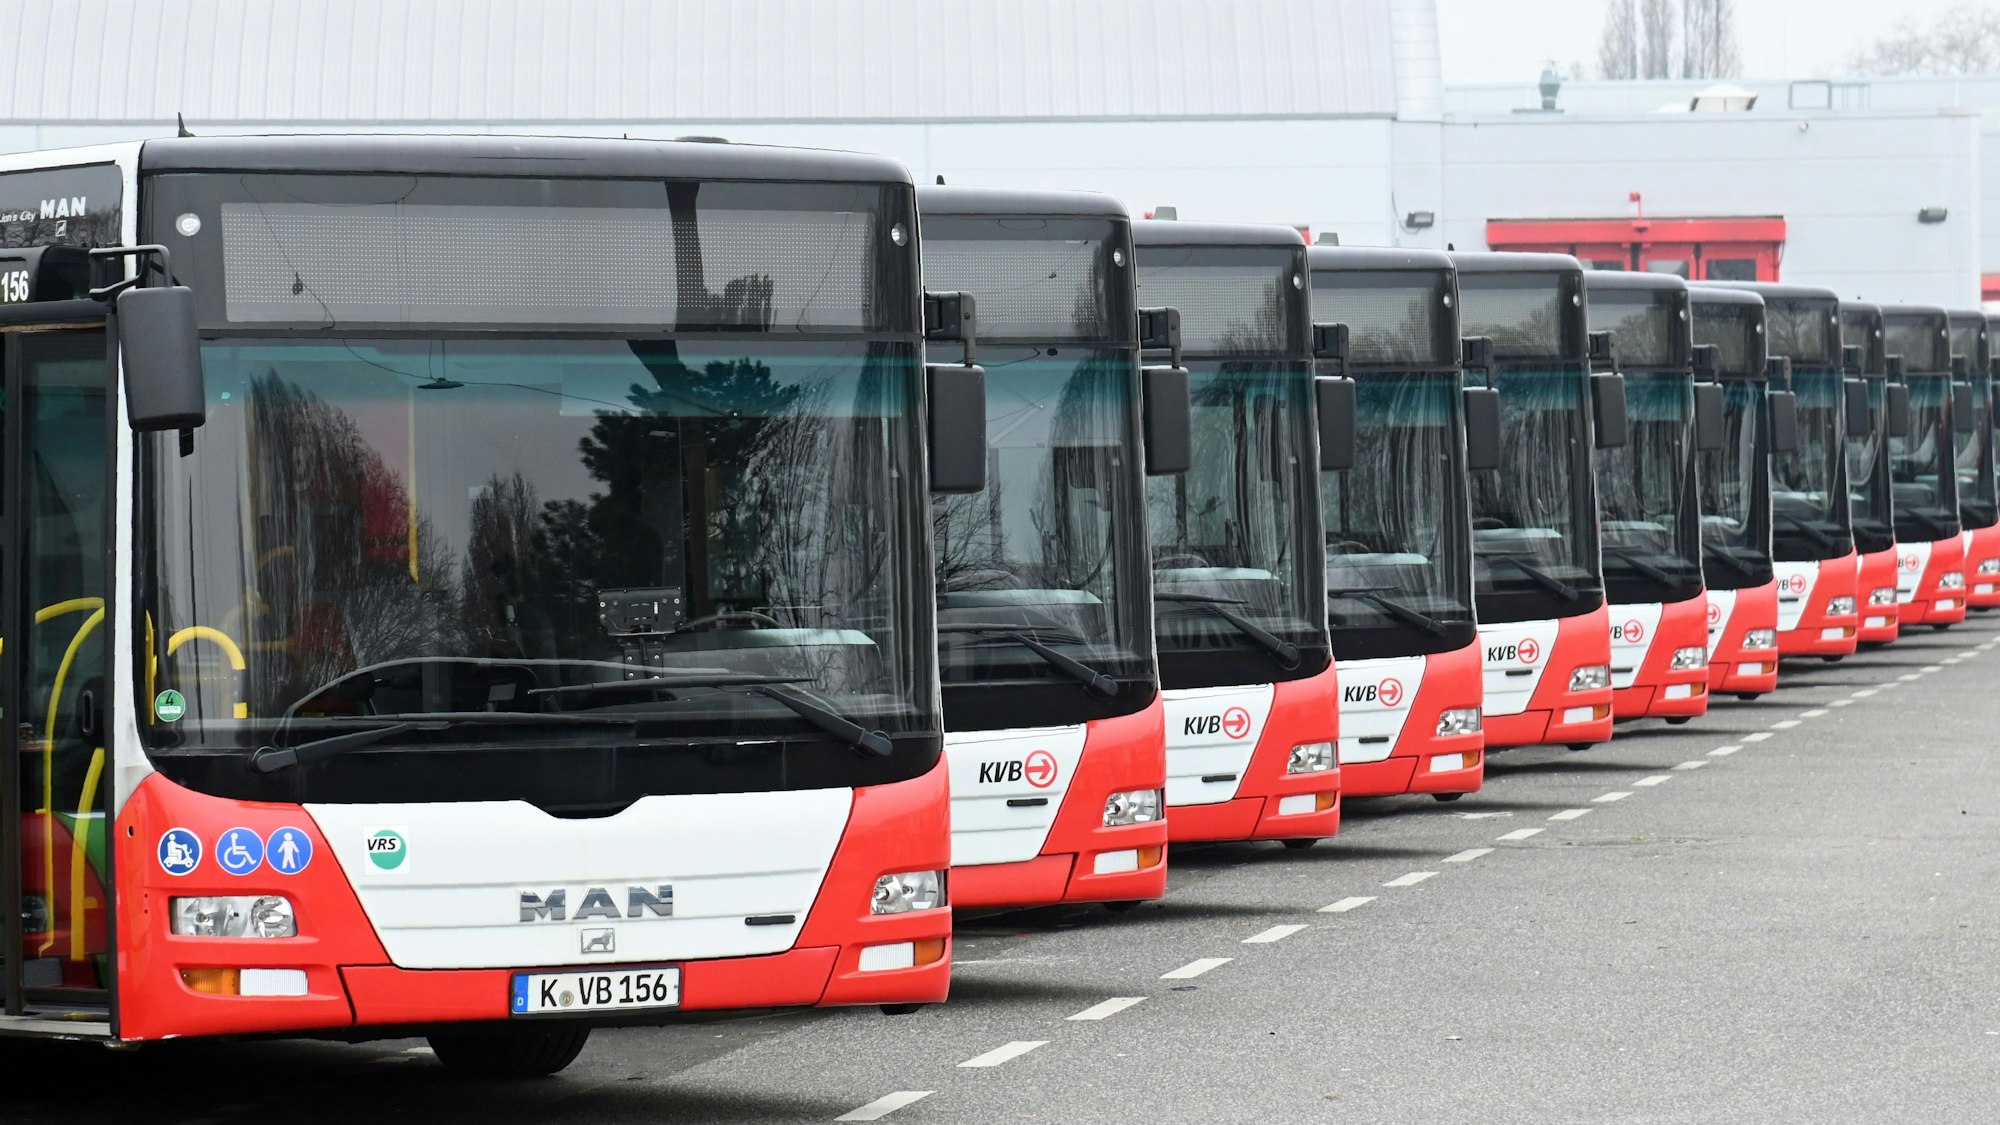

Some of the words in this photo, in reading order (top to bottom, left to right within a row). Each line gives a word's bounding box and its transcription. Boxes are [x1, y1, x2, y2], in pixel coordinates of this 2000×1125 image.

[20, 211, 36, 222] City
[40, 197, 86, 219] MAN
[1, 270, 29, 302] 156
[1488, 645, 1516, 661] KVB
[165, 692, 174, 706] 4
[1344, 685, 1377, 702] KVB
[1184, 715, 1221, 735] KVB
[979, 760, 1023, 783] KVB
[367, 838, 396, 851] VRS
[519, 884, 673, 922] MAN
[541, 979, 558, 1007] K
[578, 976, 612, 1005] VB
[619, 974, 667, 1003] 156
[517, 997, 524, 1006] D
